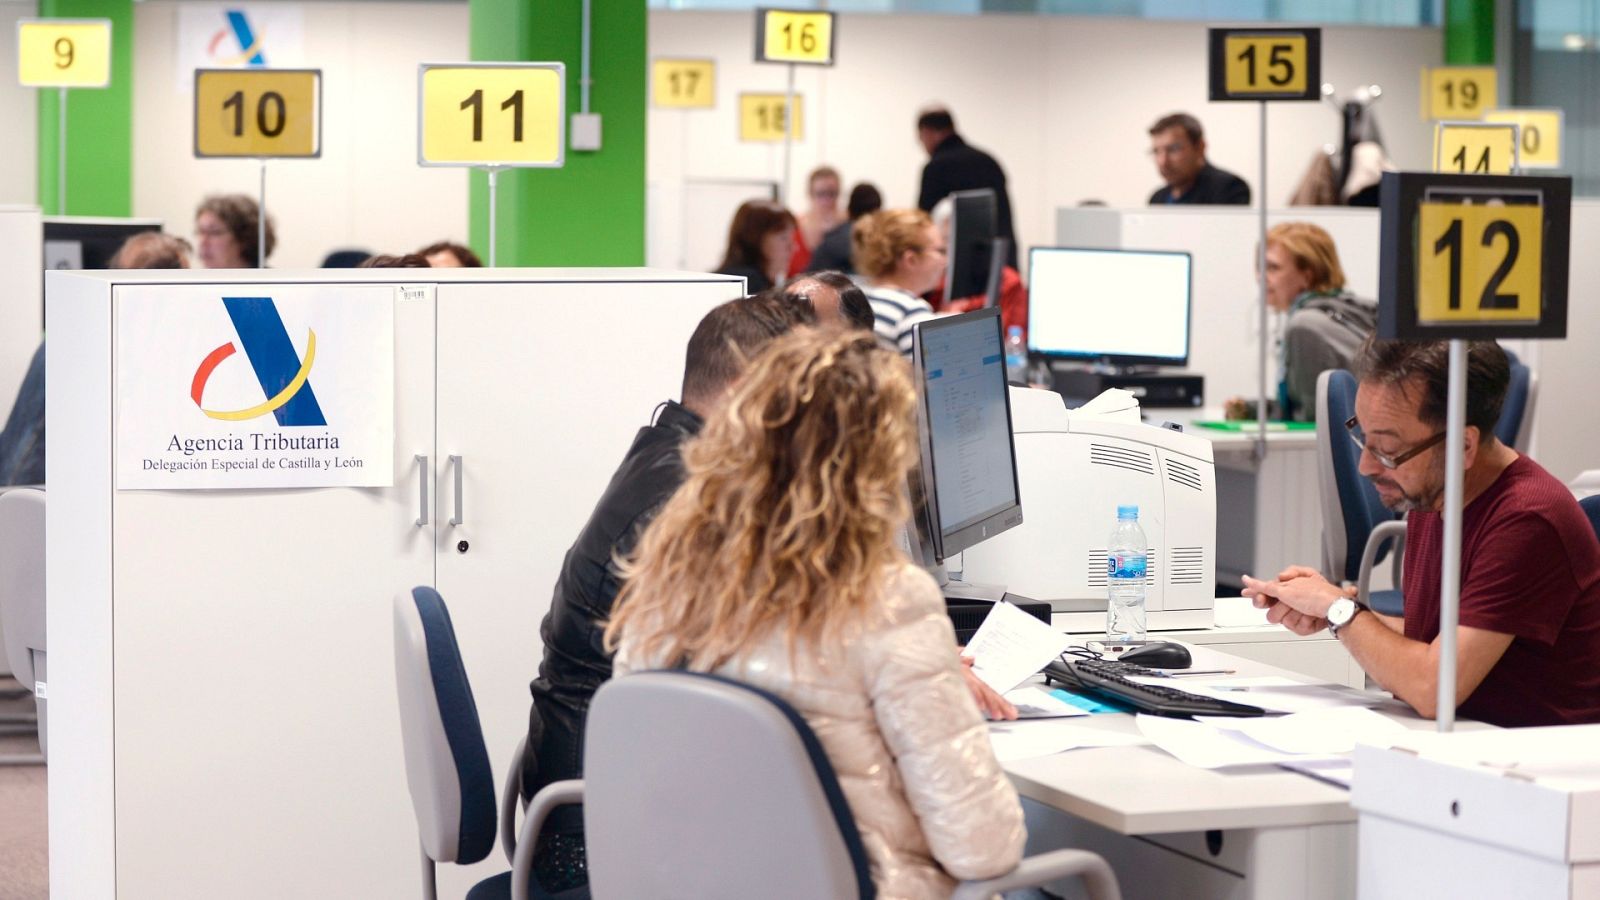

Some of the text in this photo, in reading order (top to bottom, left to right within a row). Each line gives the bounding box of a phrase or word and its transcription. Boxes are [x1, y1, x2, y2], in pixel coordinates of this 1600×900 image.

[782, 23, 816, 53] 16
[54, 38, 75, 69] 9
[1237, 45, 1295, 87] 15
[669, 70, 702, 97] 17
[1441, 80, 1480, 108] 19
[223, 91, 286, 138] 10
[460, 89, 524, 142] 11
[1434, 219, 1520, 311] 12
[167, 432, 340, 456] Agencia Tributaria
[143, 457, 363, 473] Delegación Especial de Castilla y León
